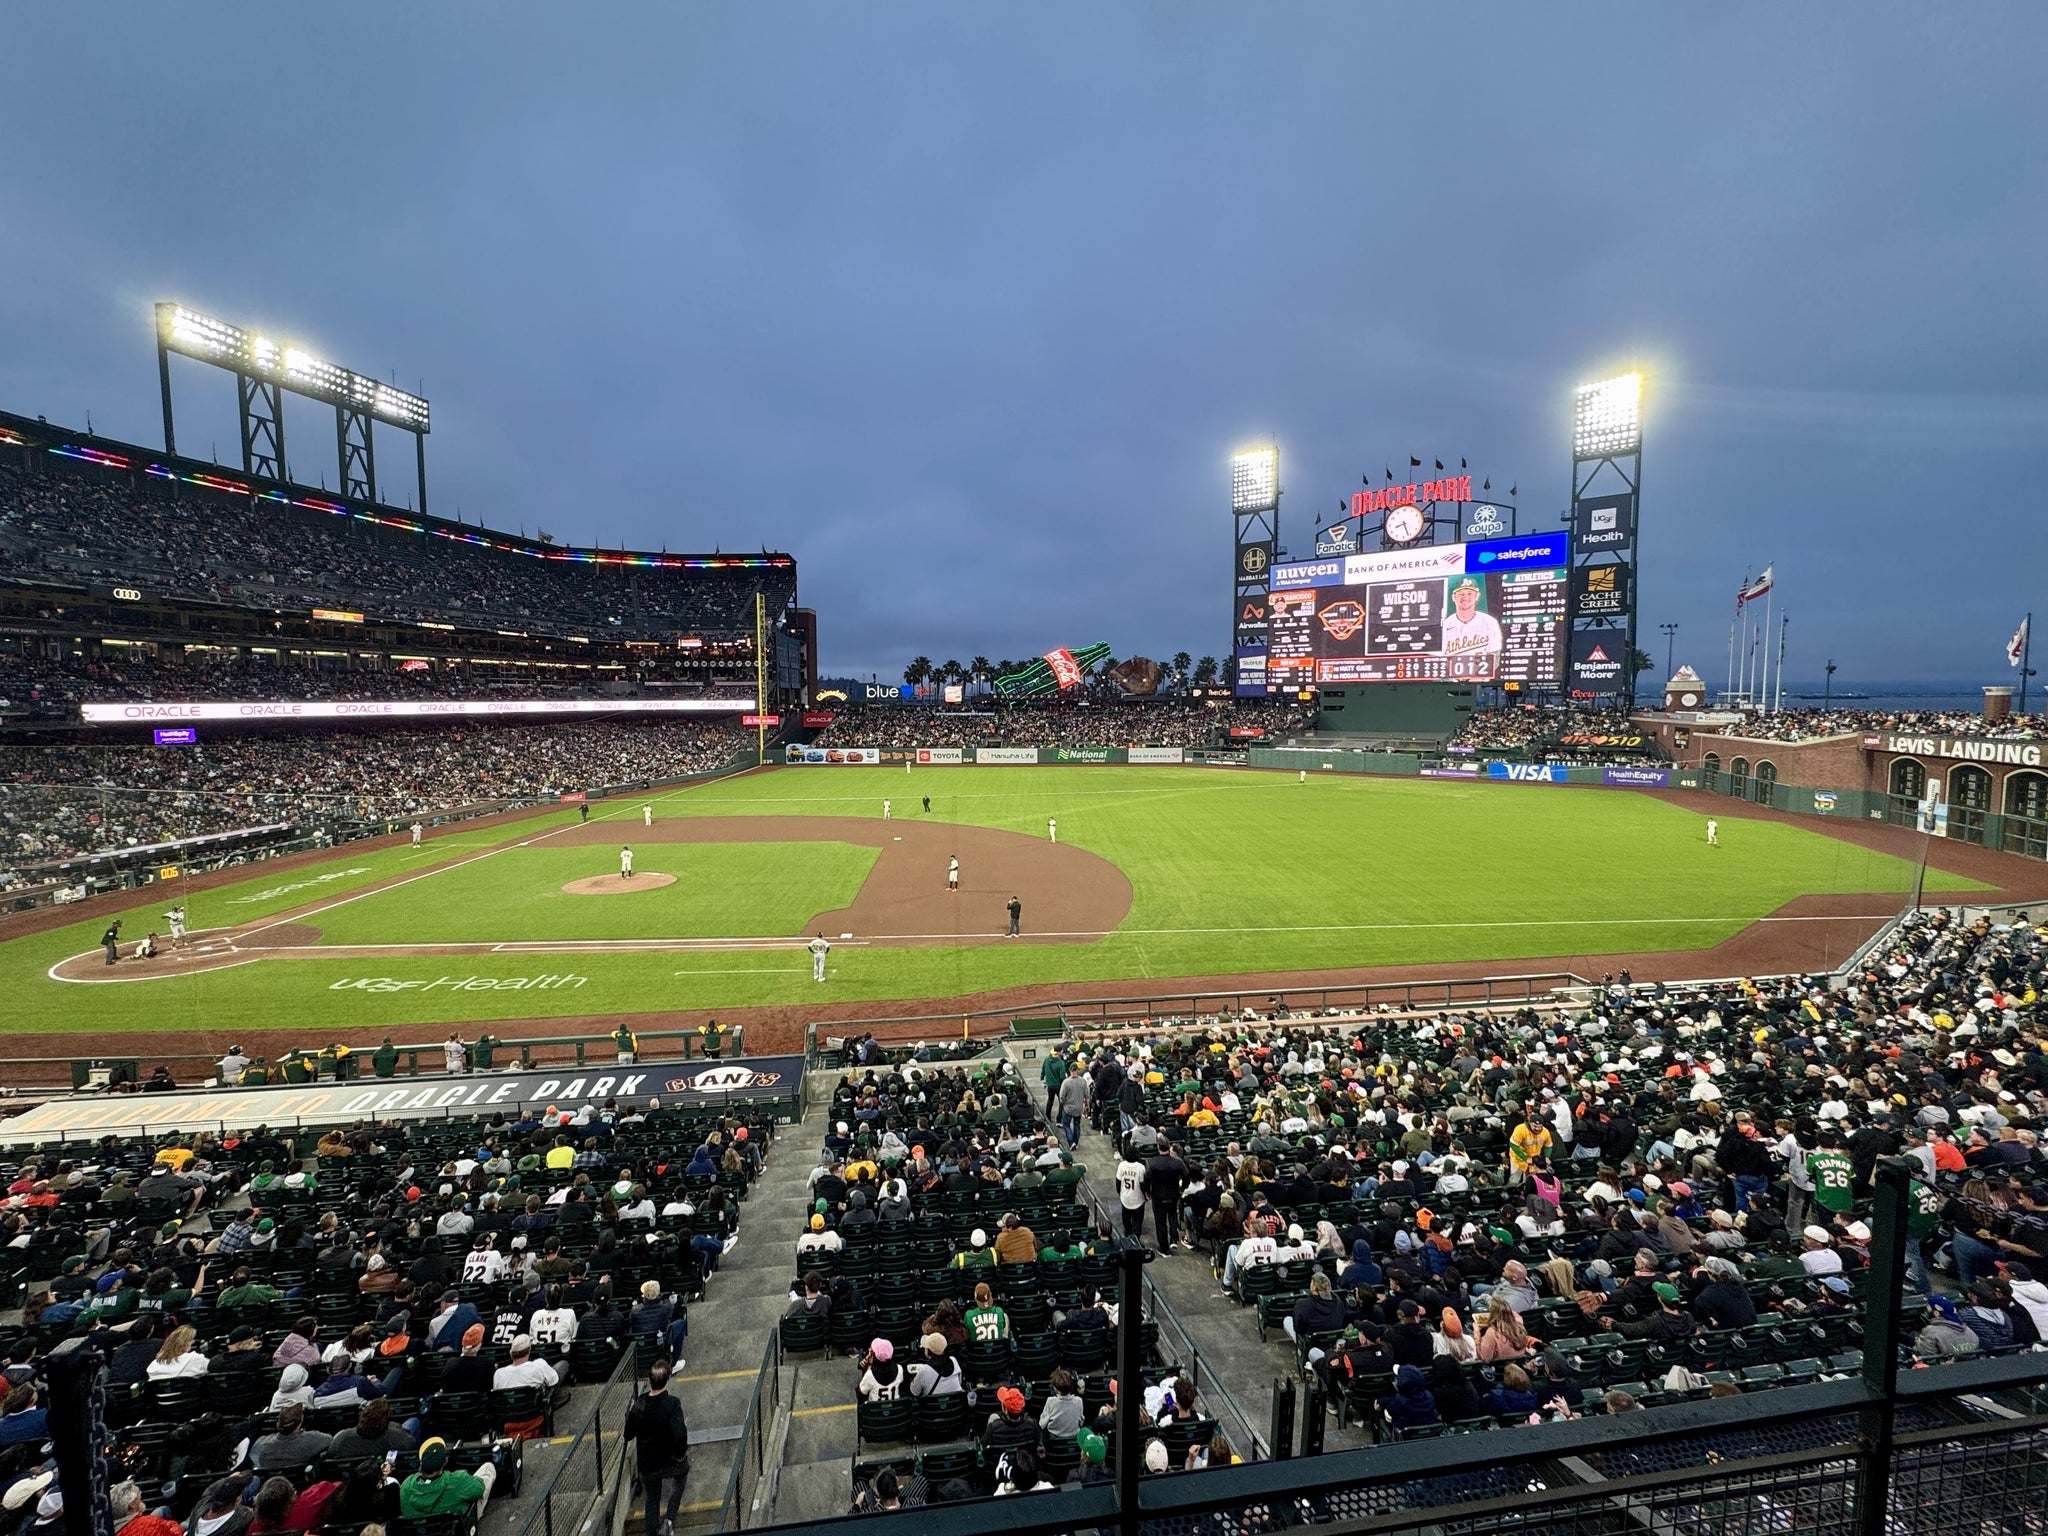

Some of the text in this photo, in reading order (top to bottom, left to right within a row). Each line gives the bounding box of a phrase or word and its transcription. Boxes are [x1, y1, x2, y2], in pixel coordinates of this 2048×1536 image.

[1351, 475, 1472, 517] ORACLE PARK
[1593, 516, 1613, 524] UCSF
[1469, 523, 1502, 535] coupa
[1582, 531, 1624, 544] Health
[1317, 541, 1357, 553] Fanatics
[1497, 548, 1551, 560] salesforce
[1276, 562, 1339, 580] nuveen
[1348, 559, 1439, 574] BANK OF AMERICA
[1515, 572, 1554, 582] ATHLETICS
[1384, 590, 1427, 606] WILSON
[1579, 590, 1622, 600] CACHE
[1580, 600, 1621, 608] CREEK
[1238, 621, 1268, 629] Airwallex
[1444, 634, 1489, 655] Athletics
[1455, 662, 1488, 675] 0 1 2
[1574, 662, 1620, 672] Benjamin
[866, 685, 899, 698] blue
[124, 706, 200, 717] ORACLE
[240, 705, 302, 715] ORACLE
[336, 704, 392, 714] ORACLE
[420, 704, 466, 712] ORACLE
[488, 703, 527, 711] ORACLE
[1560, 735, 1641, 747] 415 510
[1070, 750, 1107, 759] National
[1940, 740, 2041, 766] LANDING
[1504, 764, 1553, 781] VISA
[1608, 770, 1663, 781] HealthEquity
[1870, 810, 1882, 819] 365
[329, 974, 588, 993] UCSF Health
[666, 1072, 780, 1092] GIANTS
[20, 1075, 648, 1132] WELCOME TO ORACLE PARK
[1814, 1158, 1851, 1170] CHAPMAN
[1124, 1178, 1134, 1190] 51
[1823, 1170, 1848, 1188] 26
[1919, 1197, 1937, 1214] 26
[1255, 1256, 1271, 1264] 51
[464, 1266, 486, 1282] 22
[497, 1313, 522, 1324] BONDS
[972, 1313, 998, 1327] CANHA
[492, 1325, 517, 1344] 25
[537, 1330, 556, 1344] 51
[976, 1324, 998, 1340] 20
[878, 1387, 895, 1400] 51
